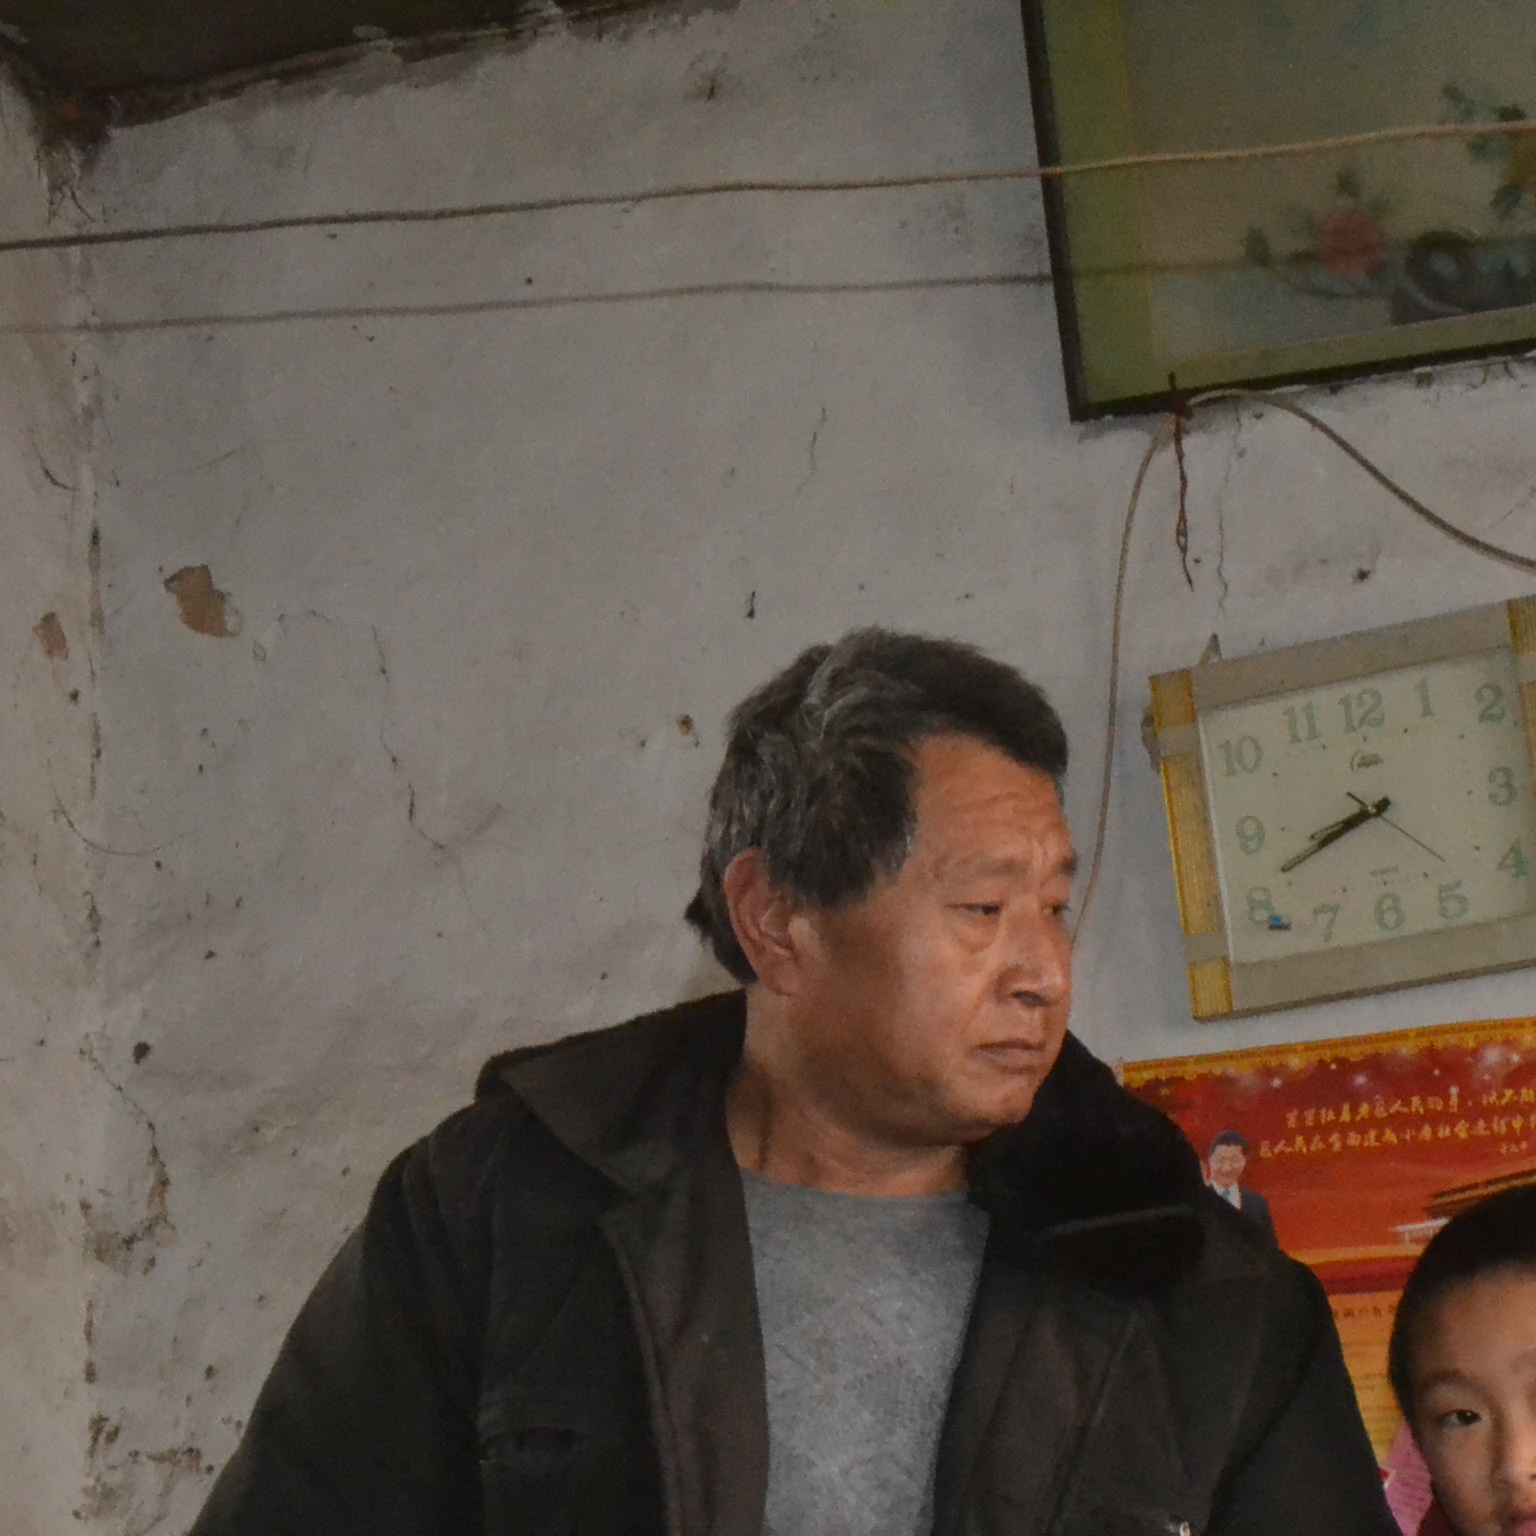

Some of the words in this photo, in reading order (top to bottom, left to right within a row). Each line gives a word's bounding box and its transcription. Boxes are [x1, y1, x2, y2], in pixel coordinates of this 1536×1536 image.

[1282, 701, 1320, 744] 11
[1338, 688, 1385, 733] 12
[1418, 678, 1435, 717] 1
[1475, 683, 1506, 724] 2
[1218, 735, 1262, 777] 10
[1488, 765, 1517, 806] 3
[1235, 815, 1265, 855] 9
[1496, 838, 1529, 879] 4
[1246, 886, 1275, 925] 8
[1313, 903, 1340, 943] 7
[1374, 893, 1406, 932] 6
[1437, 880, 1469, 921] 5
